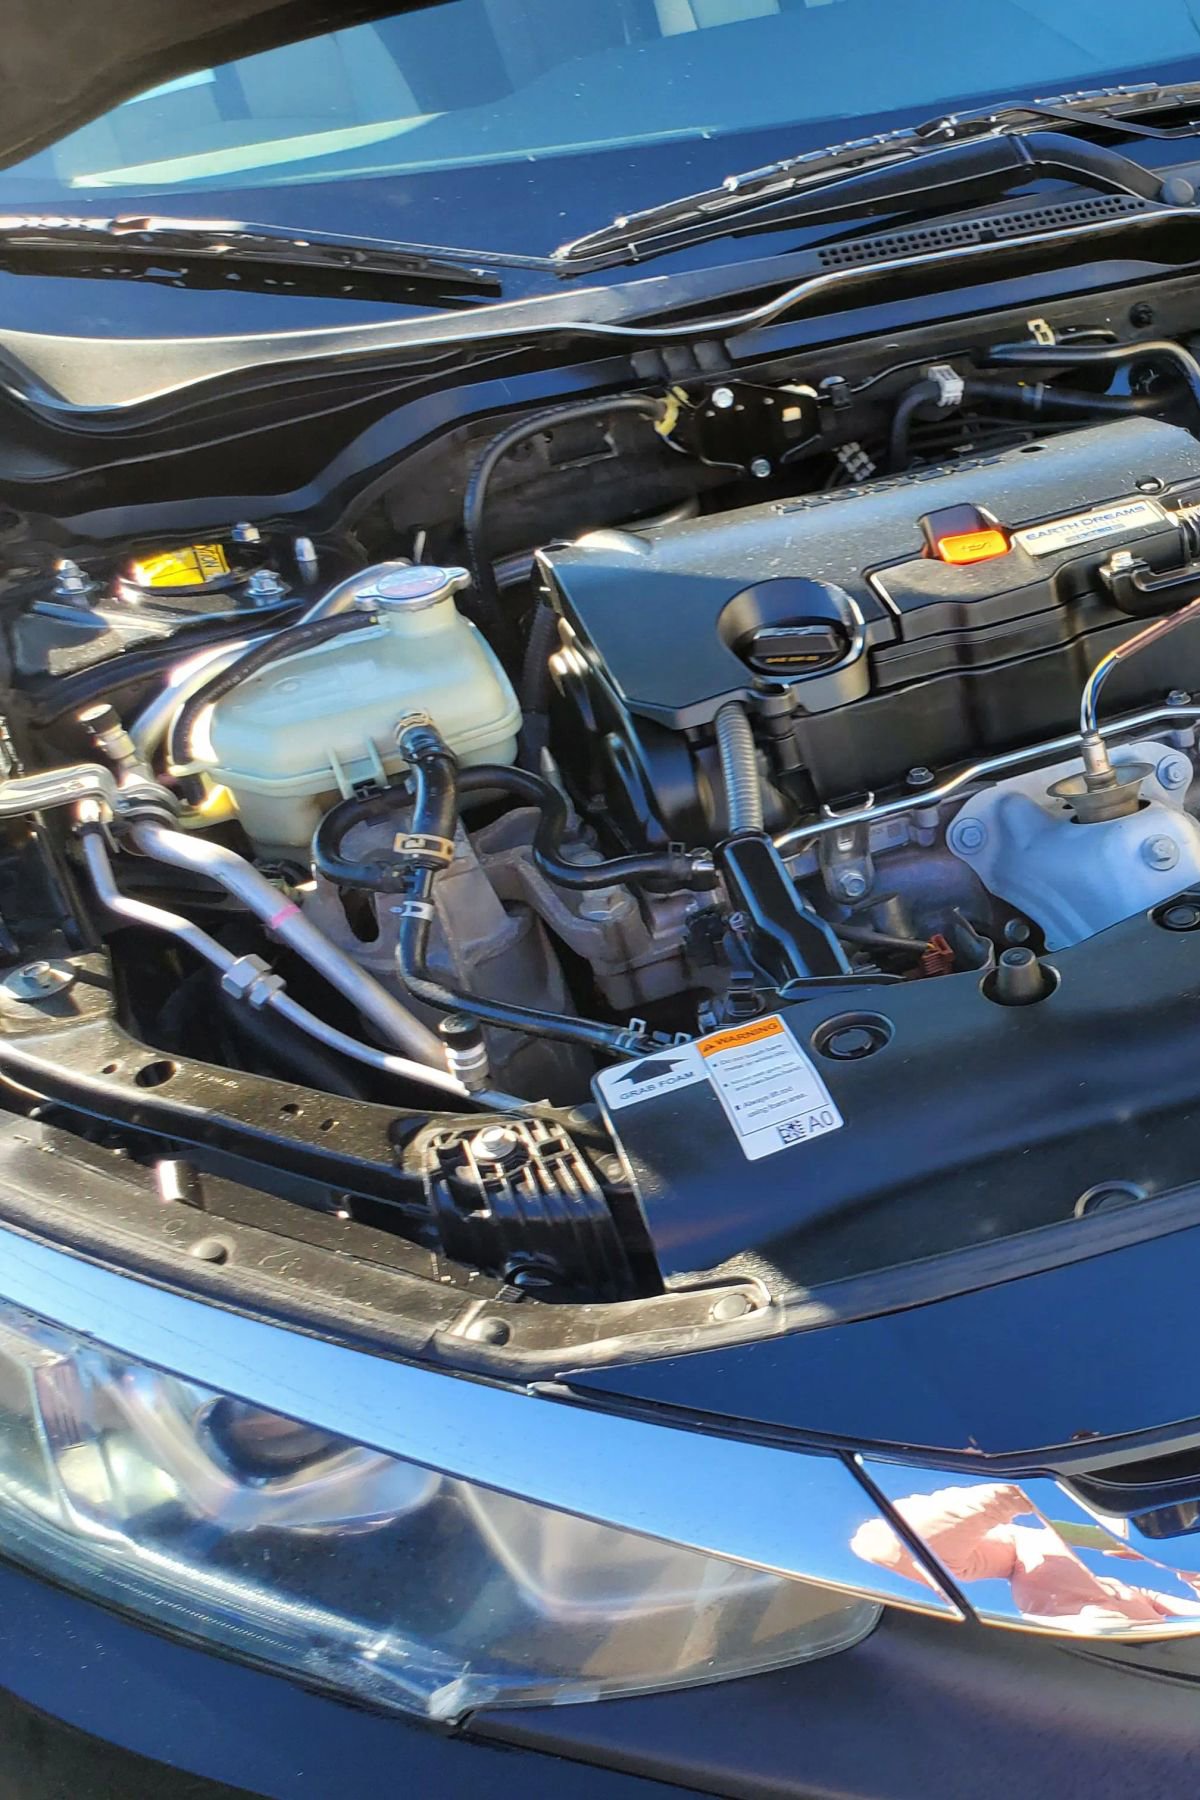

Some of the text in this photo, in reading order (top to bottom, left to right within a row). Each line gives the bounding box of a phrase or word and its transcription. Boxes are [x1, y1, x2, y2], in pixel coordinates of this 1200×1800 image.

[1026, 521, 1079, 541] EARTH
[1080, 505, 1147, 527] DREAMS
[716, 1022, 779, 1045] WARNING
[620, 1071, 694, 1100] GRAB FOAM
[808, 1110, 834, 1133] A0
